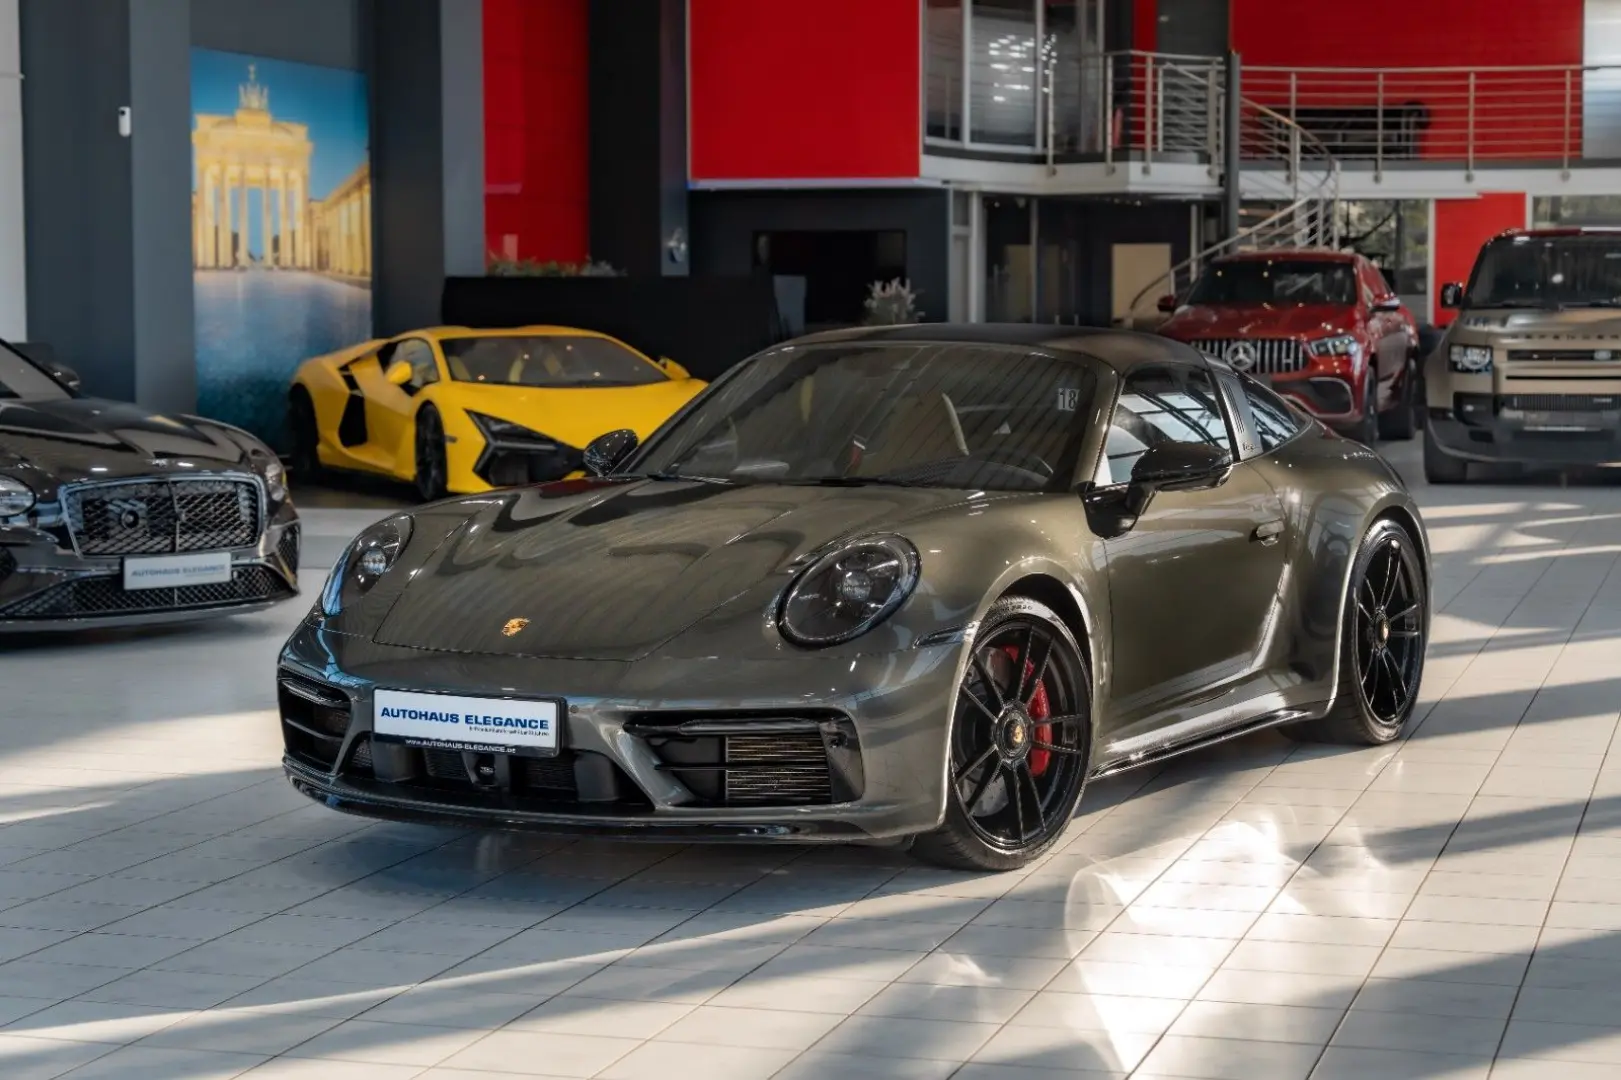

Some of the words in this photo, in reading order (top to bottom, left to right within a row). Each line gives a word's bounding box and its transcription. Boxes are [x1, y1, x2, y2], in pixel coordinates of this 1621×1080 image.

[1060, 390, 1076, 409] 18
[381, 707, 460, 724] AUTOHAUS
[465, 714, 549, 730] ELEGANCE
